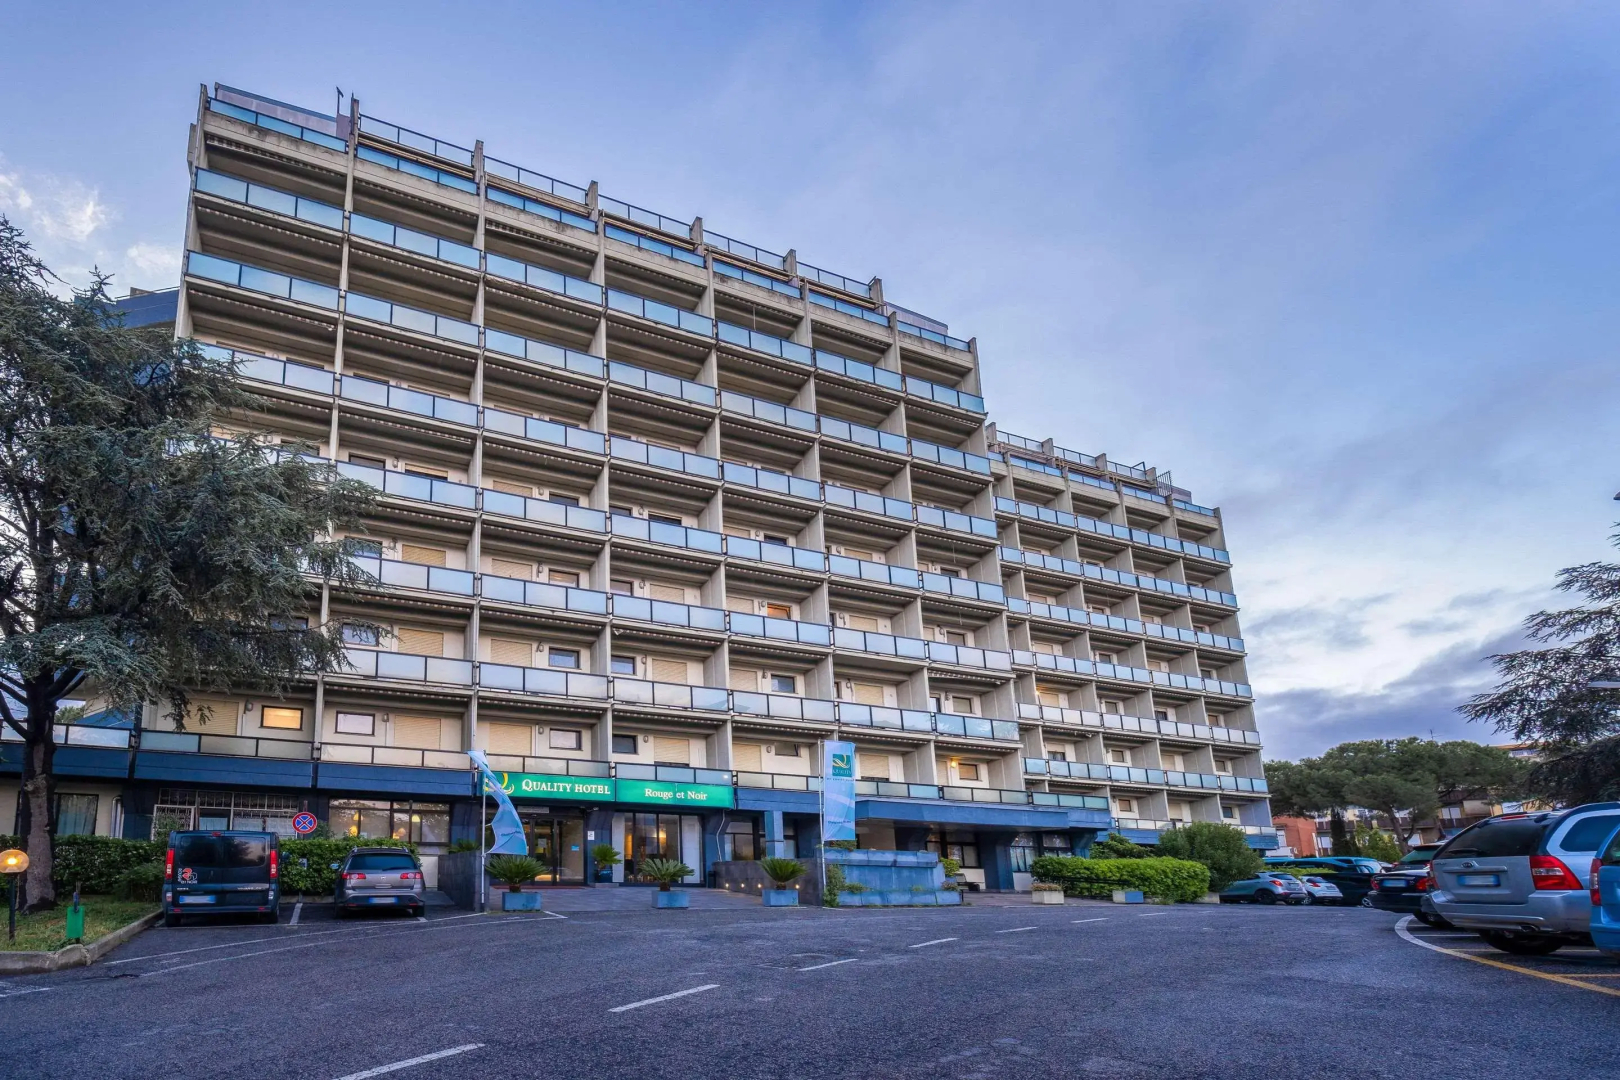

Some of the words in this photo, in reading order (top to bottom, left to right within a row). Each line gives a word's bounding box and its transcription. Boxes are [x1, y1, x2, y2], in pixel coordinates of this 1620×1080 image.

[522, 779, 572, 792] QUALITY
[574, 784, 611, 794] HOTEL
[645, 788, 673, 800] Rouge
[676, 791, 685, 799] et
[687, 791, 708, 800] Noir
